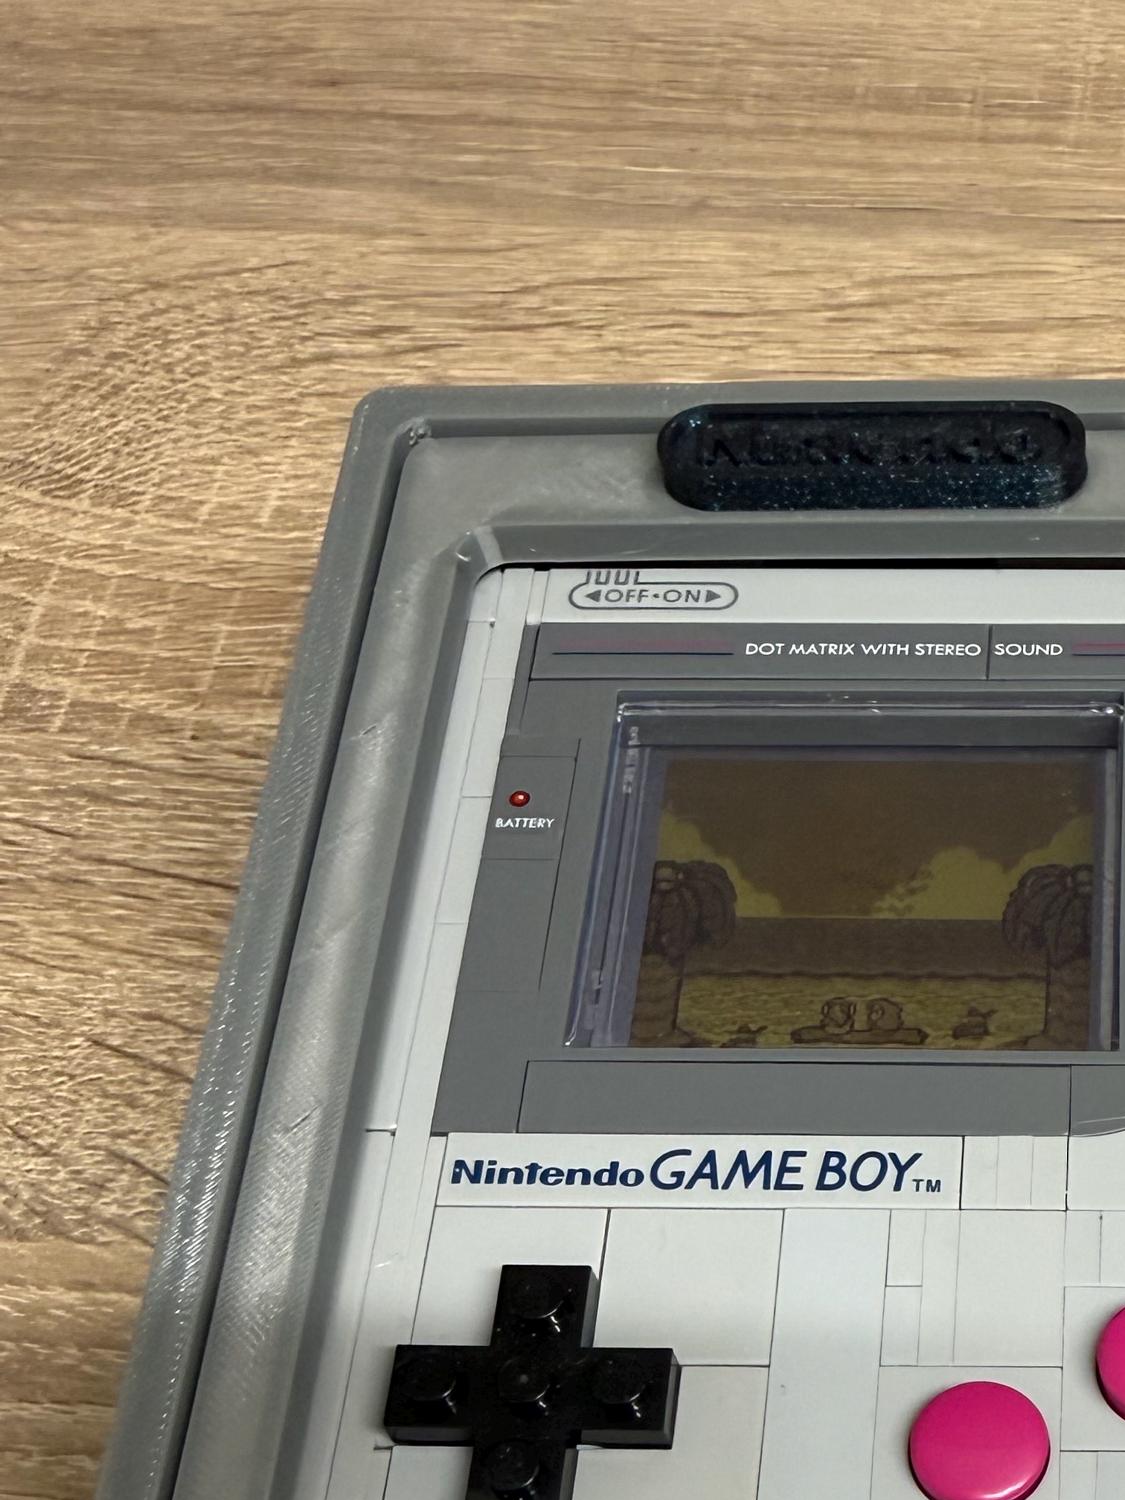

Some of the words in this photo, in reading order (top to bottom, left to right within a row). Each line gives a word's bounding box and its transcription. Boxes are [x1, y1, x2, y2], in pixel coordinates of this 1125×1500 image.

[604, 588, 649, 603] OFF
[663, 588, 701, 603] ON
[745, 642, 785, 656] DOT
[789, 642, 855, 656] MATRIX
[861, 643, 909, 656] WITH
[915, 643, 982, 657] STEREO
[994, 643, 1064, 656] SOUND
[495, 817, 555, 829] BATTERY
[451, 1158, 645, 1187] Nintendo
[649, 1148, 808, 1193] GAME
[815, 1151, 923, 1193] BOY
